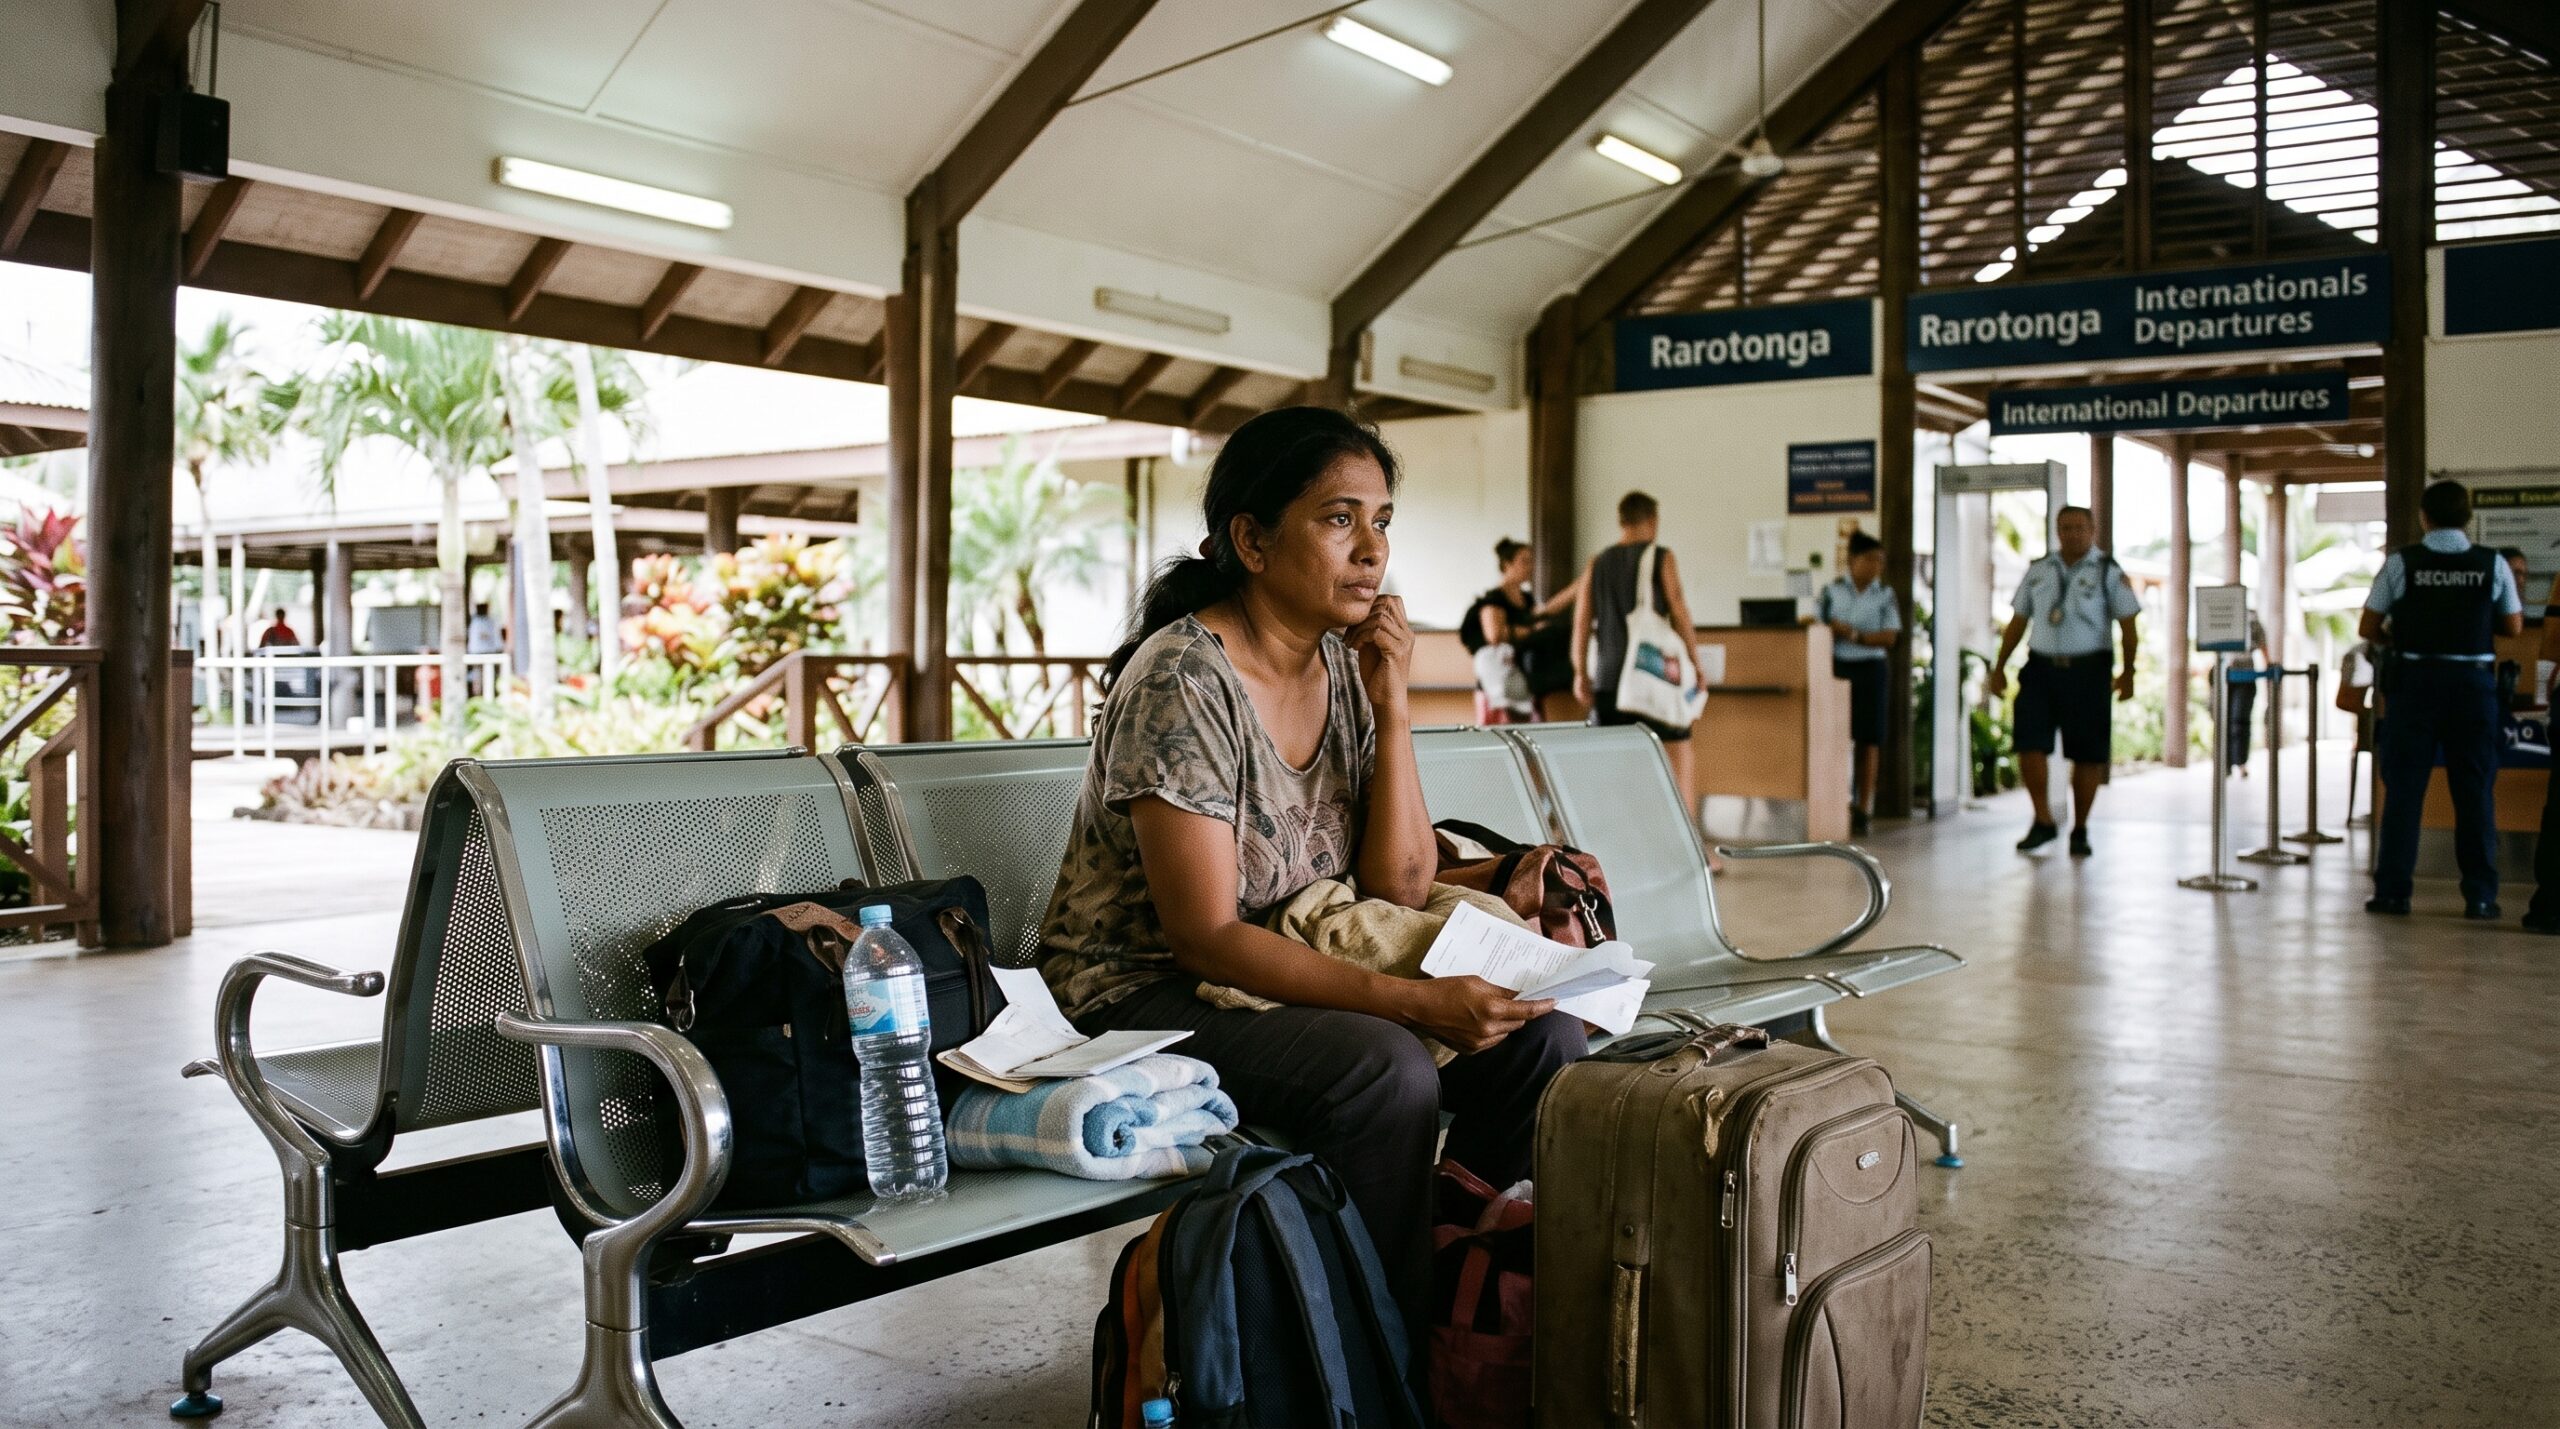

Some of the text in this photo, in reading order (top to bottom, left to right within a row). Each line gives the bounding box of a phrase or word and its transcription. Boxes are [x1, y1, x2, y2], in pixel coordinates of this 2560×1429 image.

[2134, 267, 2369, 312] Internationals
[1918, 309, 2102, 347] Rarotonga
[2134, 310, 2314, 348] Departures
[1650, 329, 1831, 368] Rarotonga
[2001, 388, 2331, 426] International Departures
[2414, 570, 2486, 587] SECURITY
